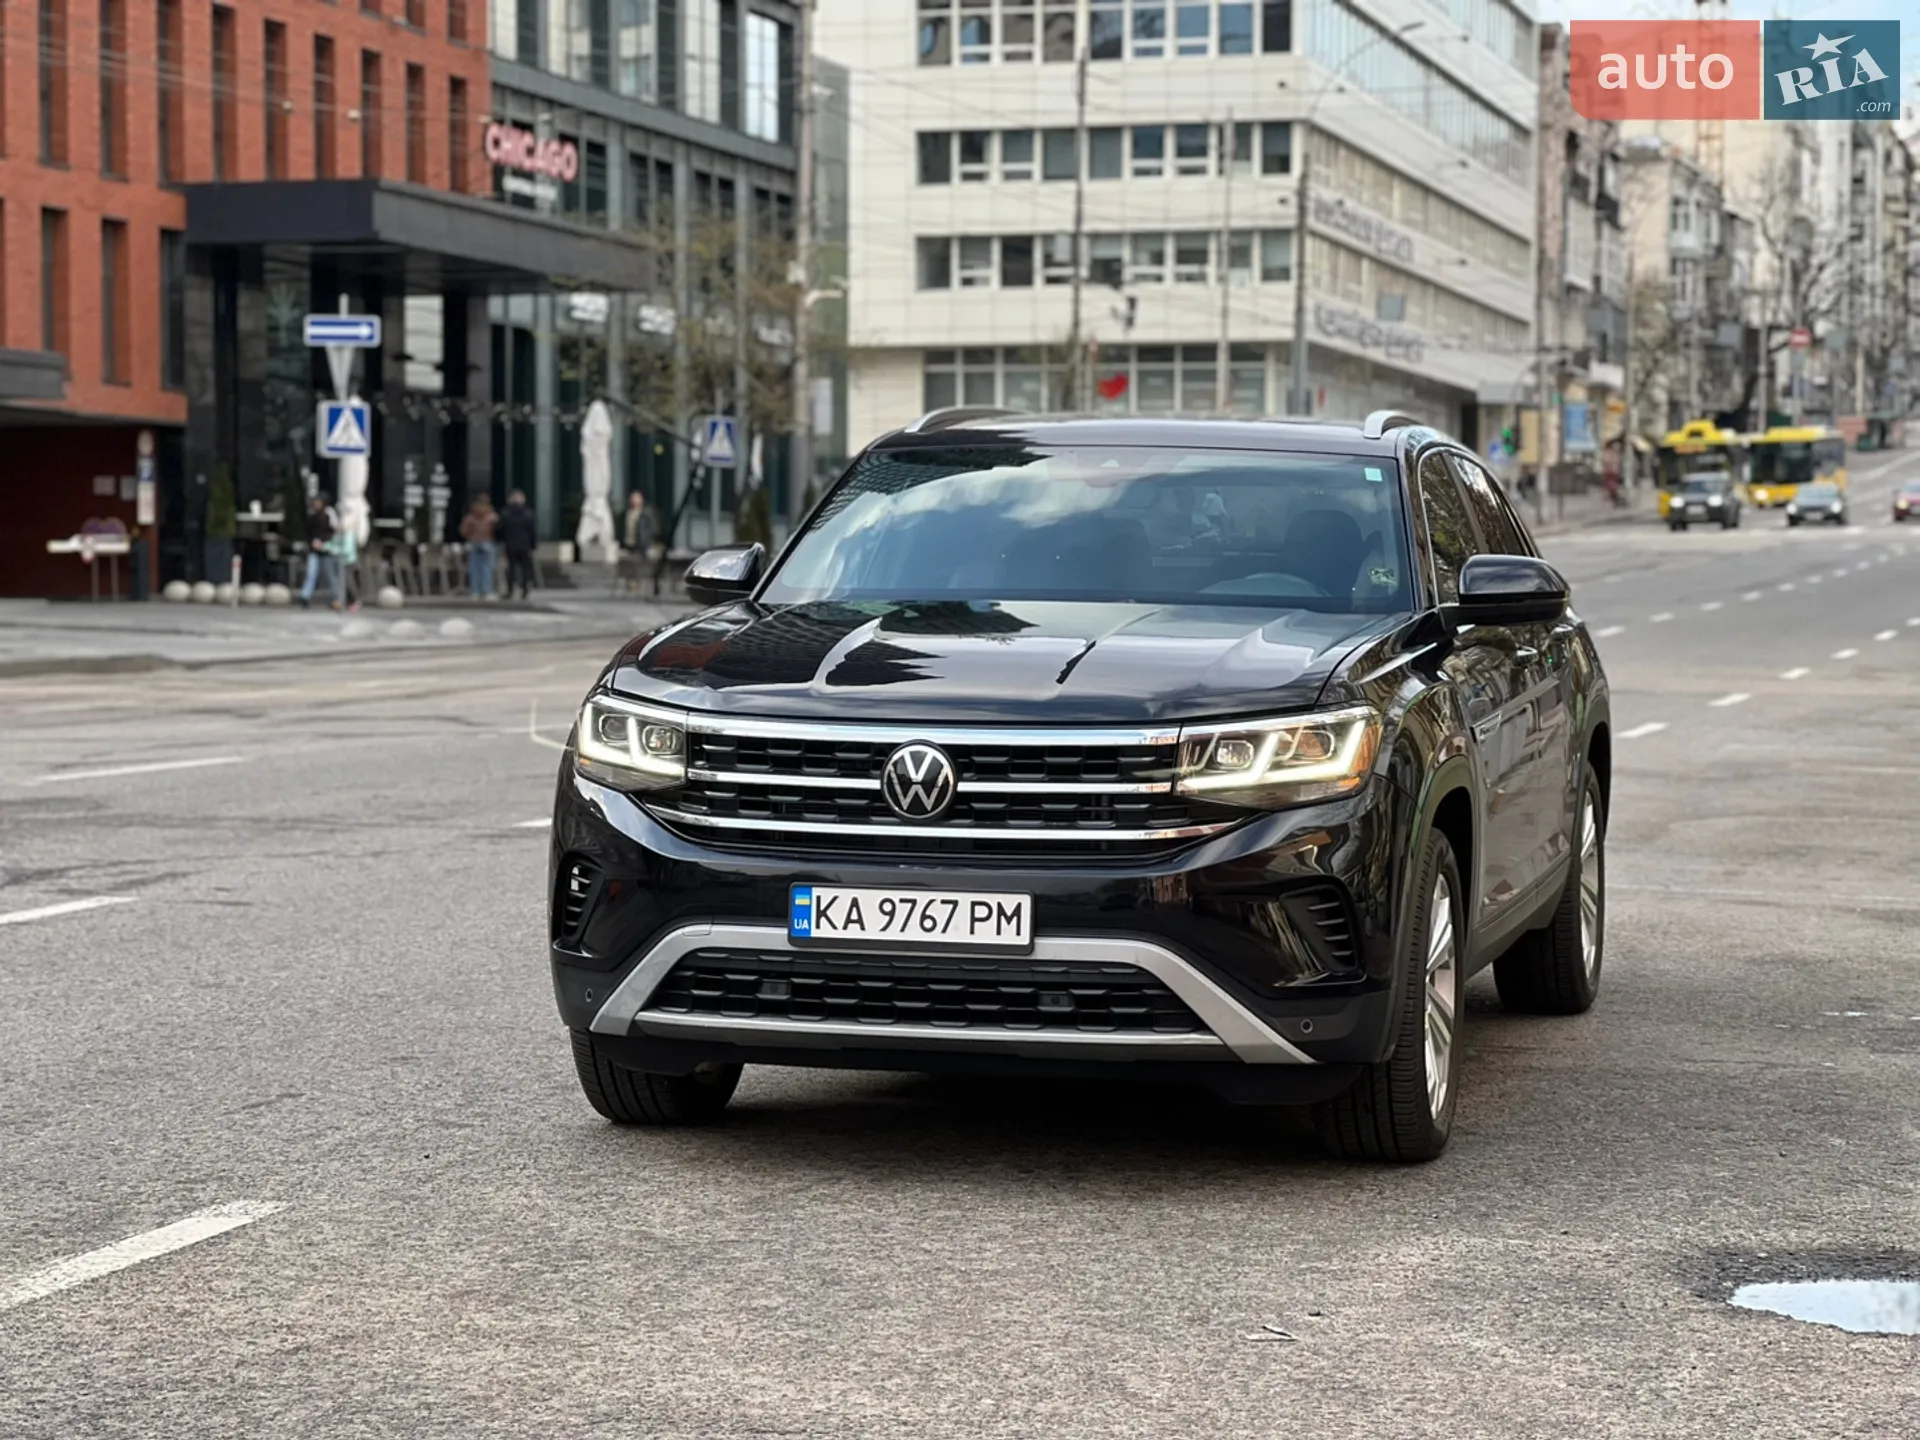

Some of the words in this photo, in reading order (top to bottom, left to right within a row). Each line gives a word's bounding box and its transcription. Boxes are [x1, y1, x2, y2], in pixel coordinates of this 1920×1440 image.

[485, 122, 579, 183] CHICAGO
[794, 918, 809, 930] UA
[815, 894, 866, 931] KA
[878, 897, 959, 934] 9767
[969, 900, 1023, 937] PM
